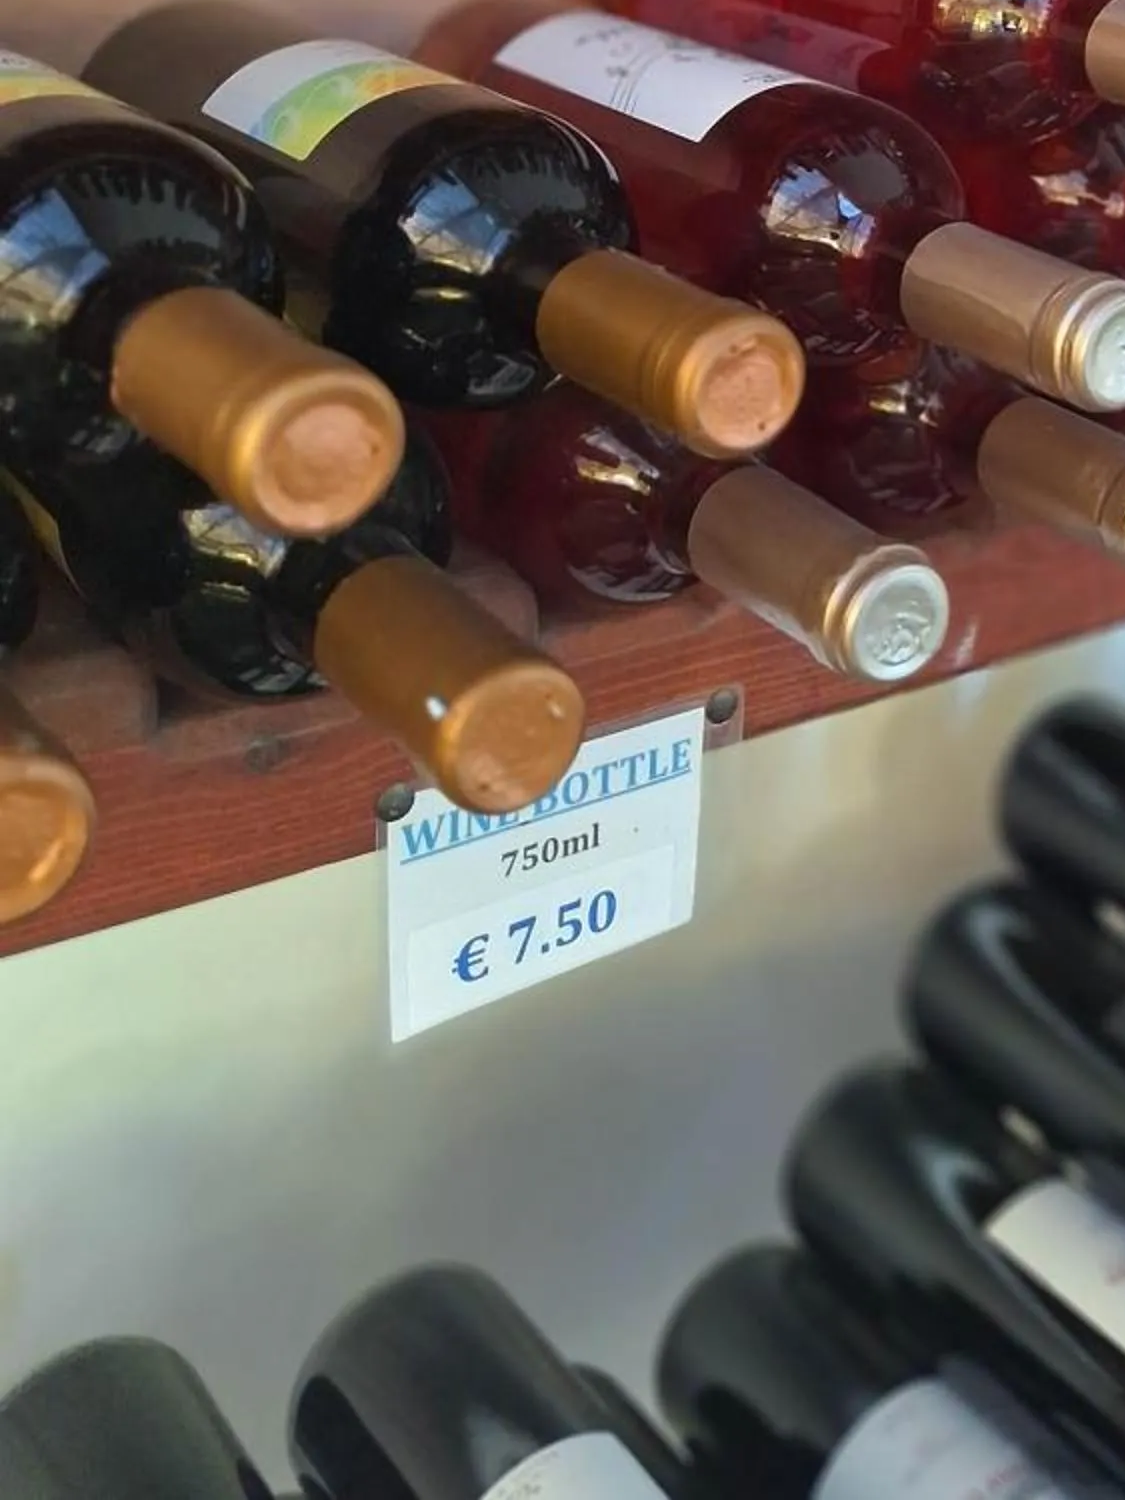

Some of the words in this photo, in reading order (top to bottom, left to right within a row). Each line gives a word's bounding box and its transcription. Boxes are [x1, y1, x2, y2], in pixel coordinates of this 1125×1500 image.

[500, 822, 601, 878] 750ml
[451, 933, 490, 983] €
[508, 889, 617, 966] 7.50
